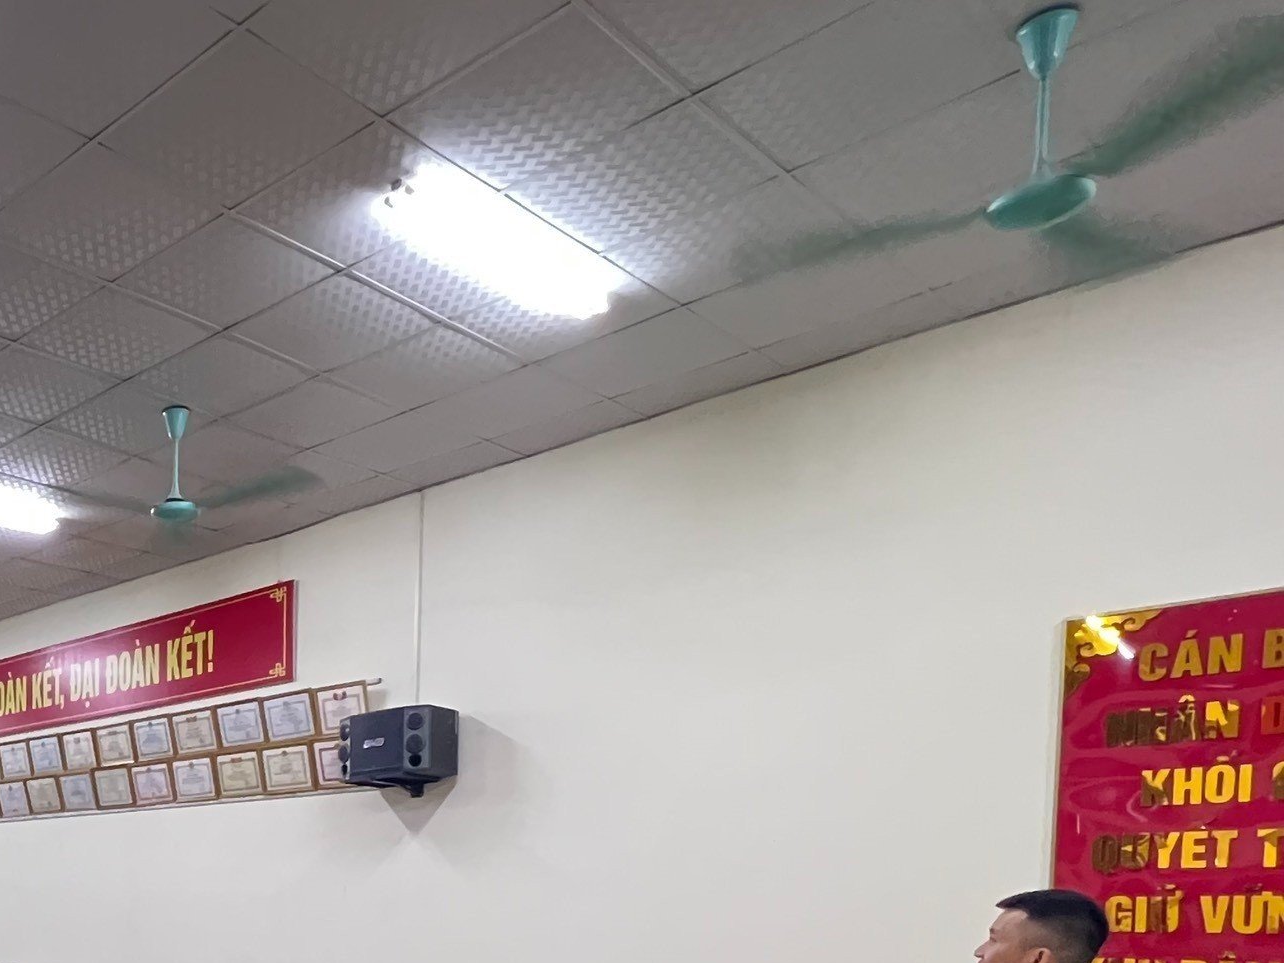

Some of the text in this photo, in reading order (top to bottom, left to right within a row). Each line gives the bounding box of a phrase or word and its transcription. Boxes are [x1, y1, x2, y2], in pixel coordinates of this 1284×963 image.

[31, 656, 65, 713] KẾT,
[69, 657, 101, 709] ĐẠI
[105, 638, 160, 694] ĐOÀN
[166, 619, 214, 682] KẾT!
[1138, 629, 1243, 682] CÁN
[1140, 749, 1253, 807] KHỐI
[1105, 884, 1184, 933] GIỮ
